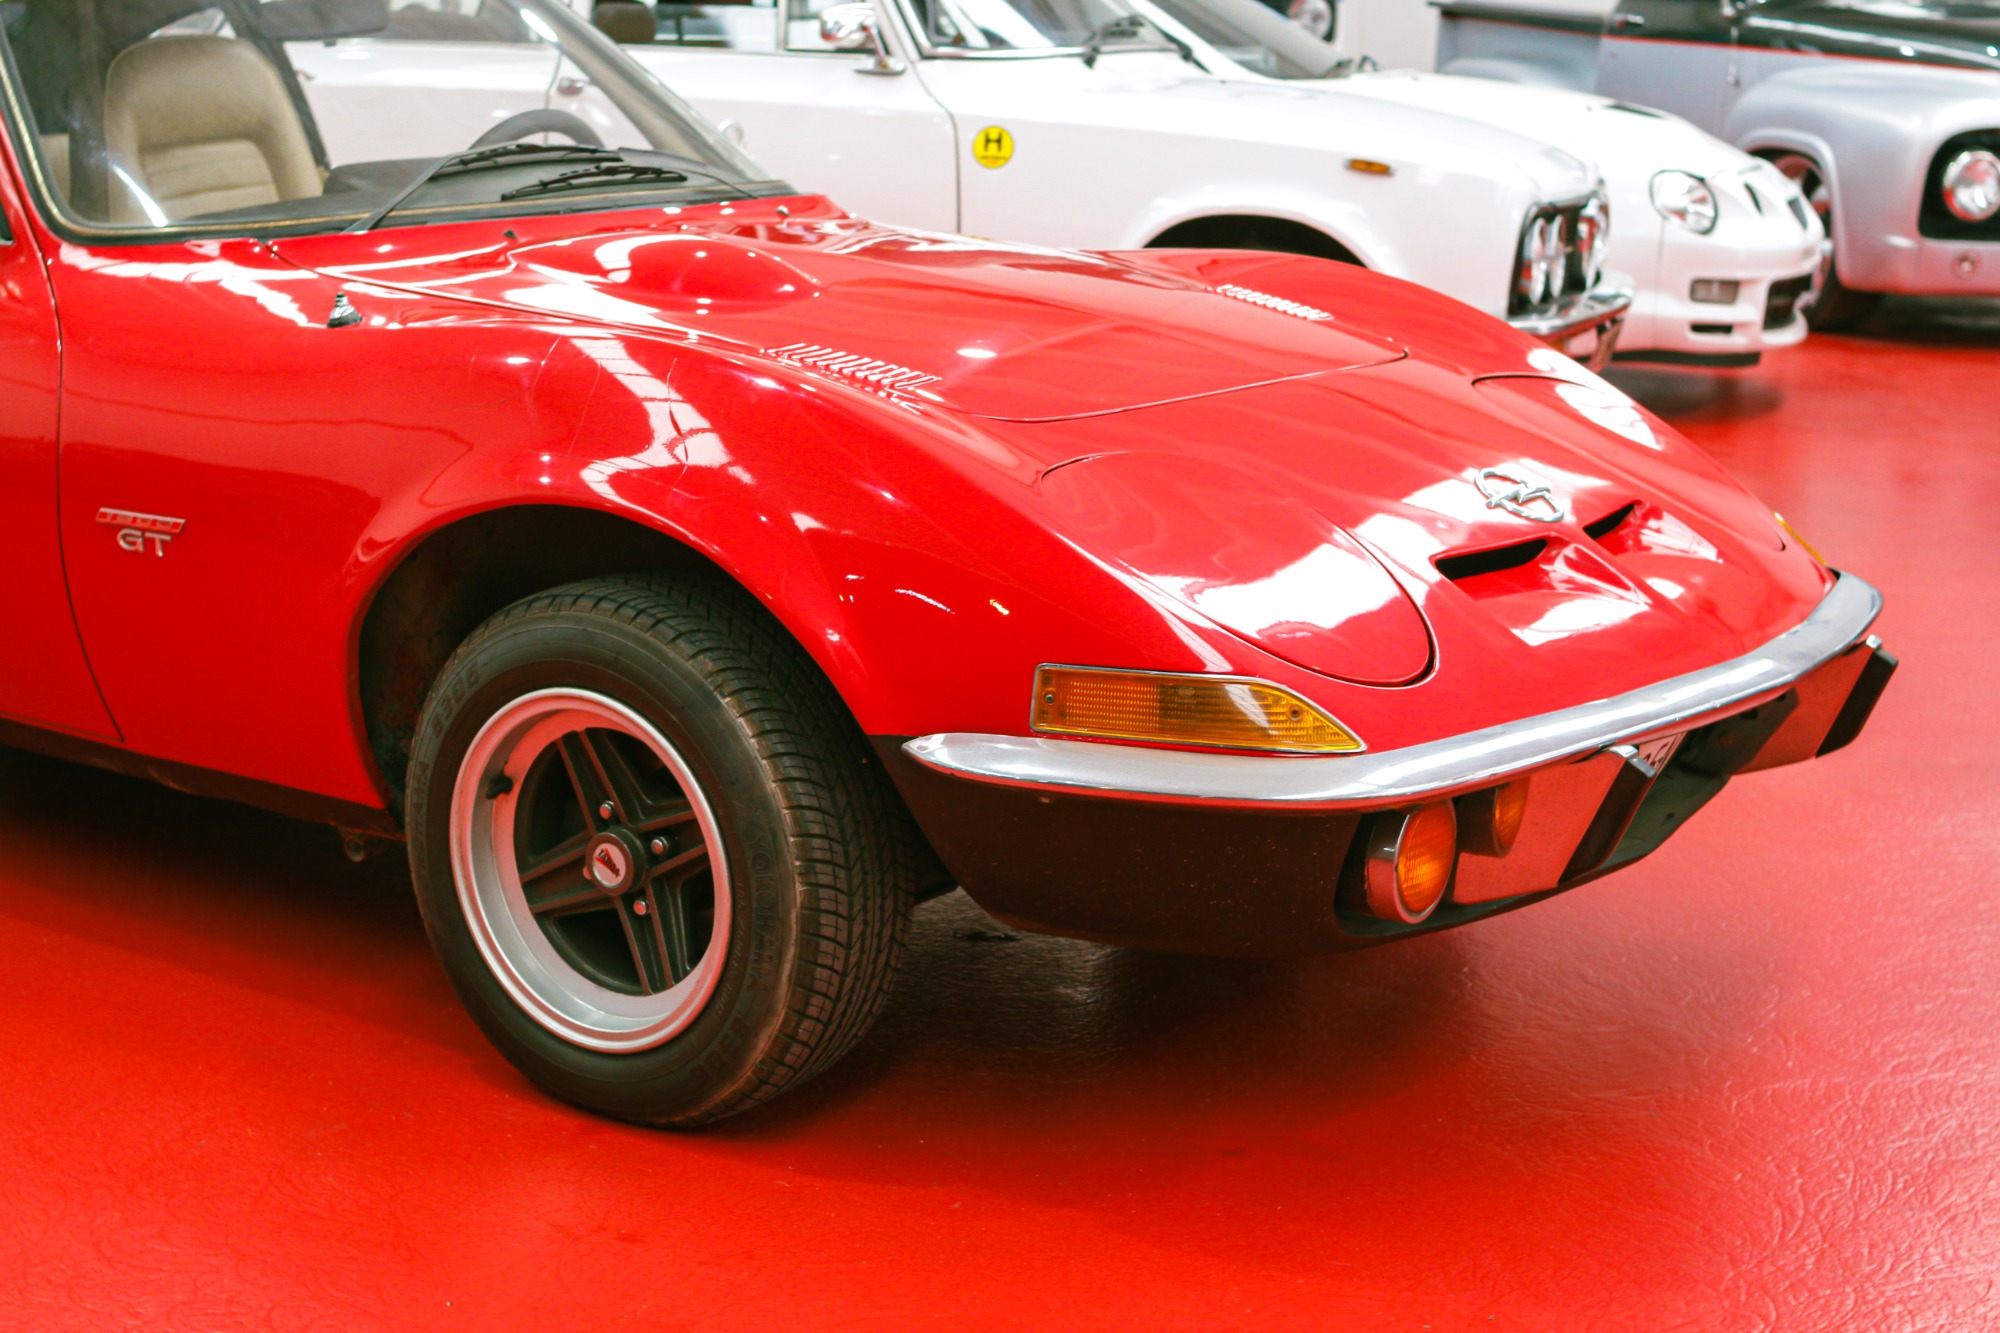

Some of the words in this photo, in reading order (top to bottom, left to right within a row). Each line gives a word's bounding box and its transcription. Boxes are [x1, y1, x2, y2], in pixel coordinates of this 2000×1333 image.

[984, 131, 1002, 152] H
[116, 528, 171, 557] GT
[747, 833, 780, 992] YOKOHAMA
